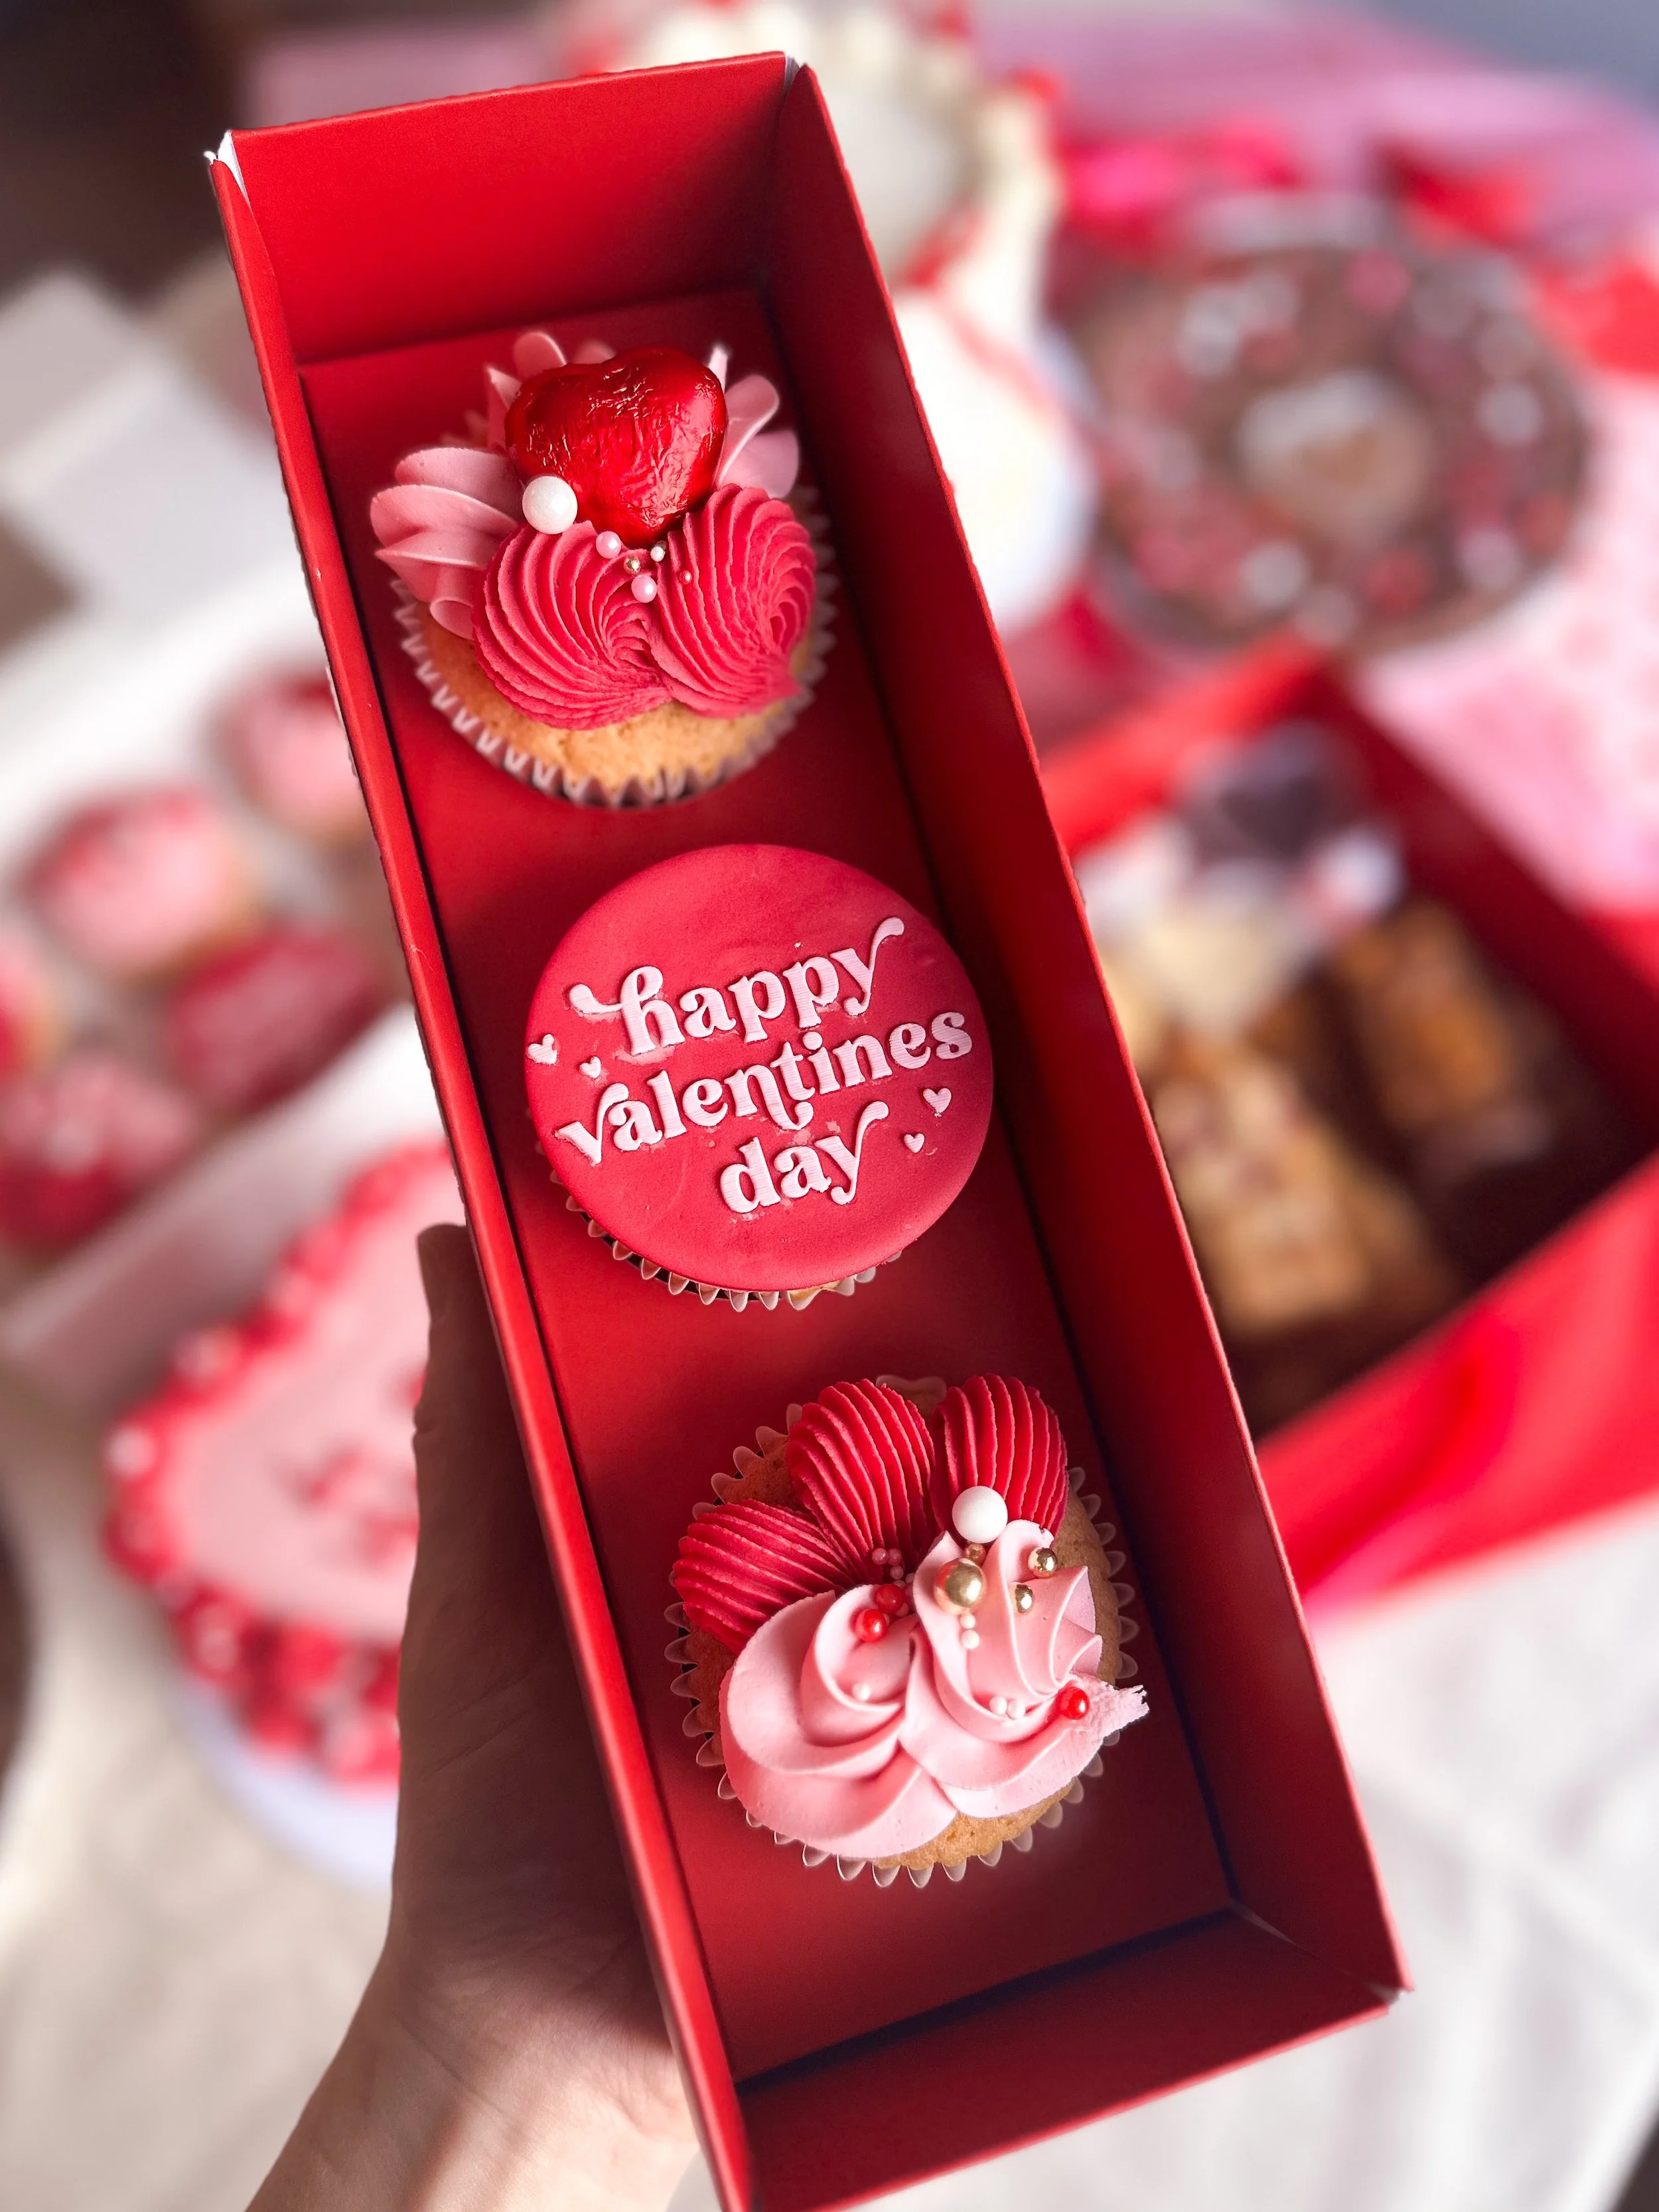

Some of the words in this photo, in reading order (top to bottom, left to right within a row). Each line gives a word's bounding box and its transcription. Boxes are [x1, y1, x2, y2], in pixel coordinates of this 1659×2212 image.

[569, 917, 904, 1055] happy
[557, 1011, 972, 1165] valentines
[719, 1100, 889, 1213] day
